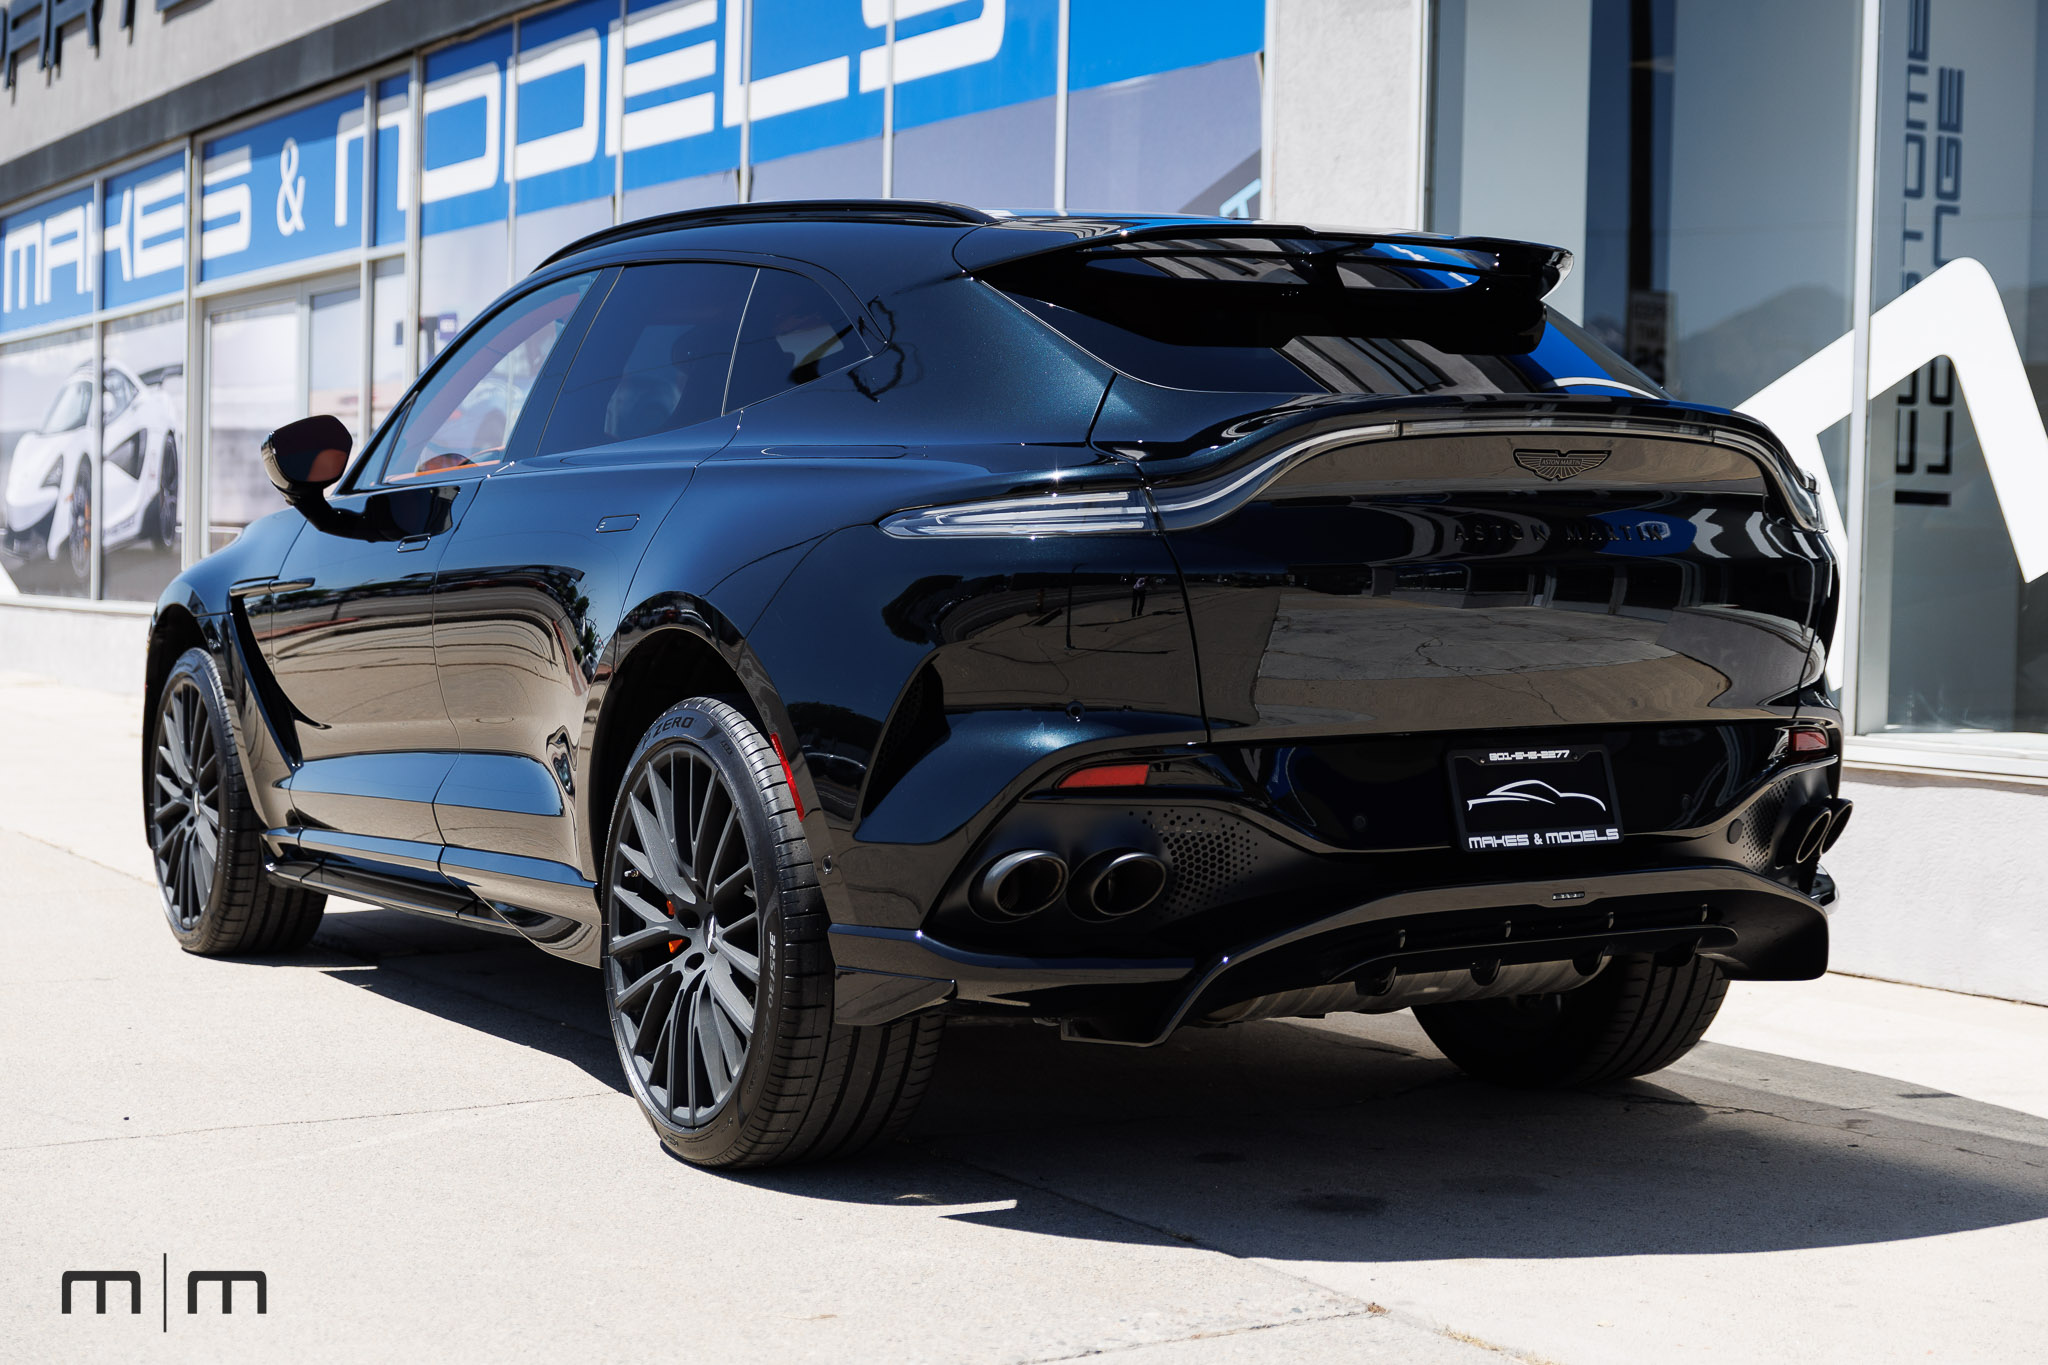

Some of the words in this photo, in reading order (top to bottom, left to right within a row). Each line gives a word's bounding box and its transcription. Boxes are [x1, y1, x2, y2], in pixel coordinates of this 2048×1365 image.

[4, 145, 252, 313] MAKES
[276, 138, 305, 237] &
[1455, 523, 1549, 541] ASTON
[1565, 523, 1664, 541] MARTIN
[653, 716, 695, 738] ZERO
[1468, 834, 1530, 849] MAKES
[1534, 833, 1543, 845] &
[1545, 828, 1619, 844] MODELS
